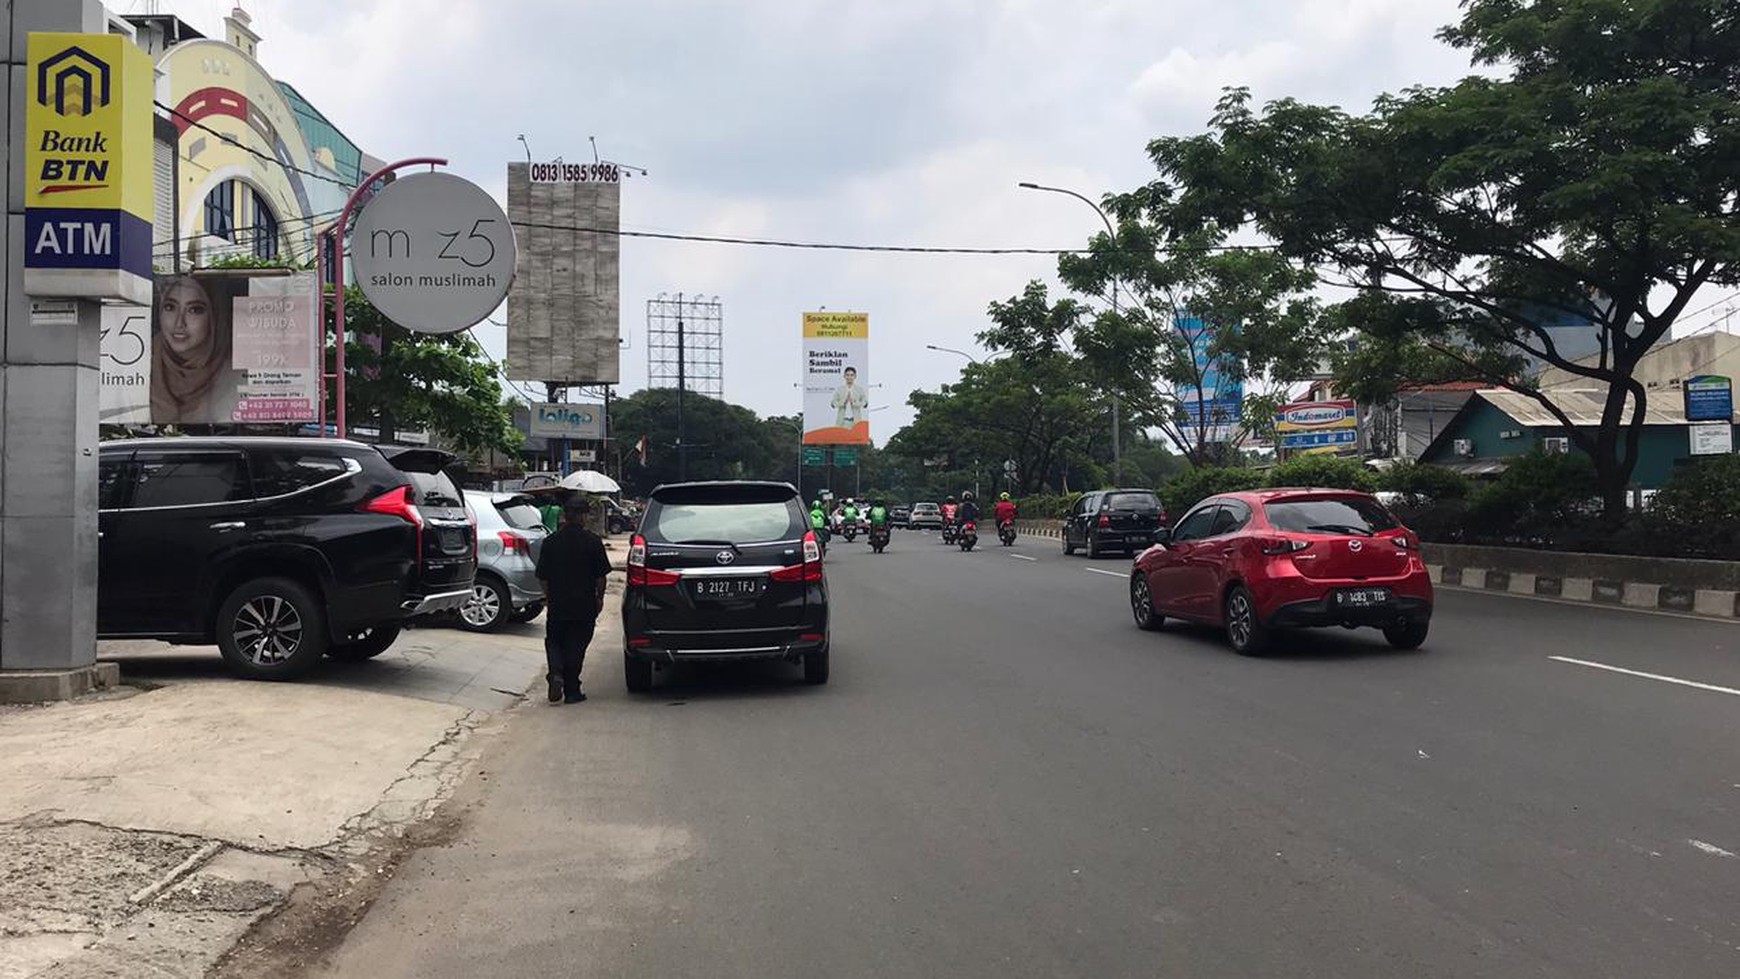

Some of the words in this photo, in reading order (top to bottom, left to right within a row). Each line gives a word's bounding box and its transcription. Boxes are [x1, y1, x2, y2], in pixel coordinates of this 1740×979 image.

[39, 129, 108, 153] Bank
[39, 158, 110, 182] BTN
[531, 163, 557, 182] 0813
[562, 164, 588, 182] 1585
[590, 164, 619, 182] 9986
[34, 221, 112, 255] ATM
[371, 272, 413, 287] salon
[419, 272, 496, 288] muslimah
[806, 314, 830, 323] Space
[832, 314, 867, 323] Available
[809, 350, 849, 358] Beriklan
[809, 359, 843, 367] Sambil
[1288, 410, 1341, 422] Indomaret
[697, 582, 704, 594] B
[709, 581, 731, 594] 2127
[737, 581, 755, 593] TFJ
